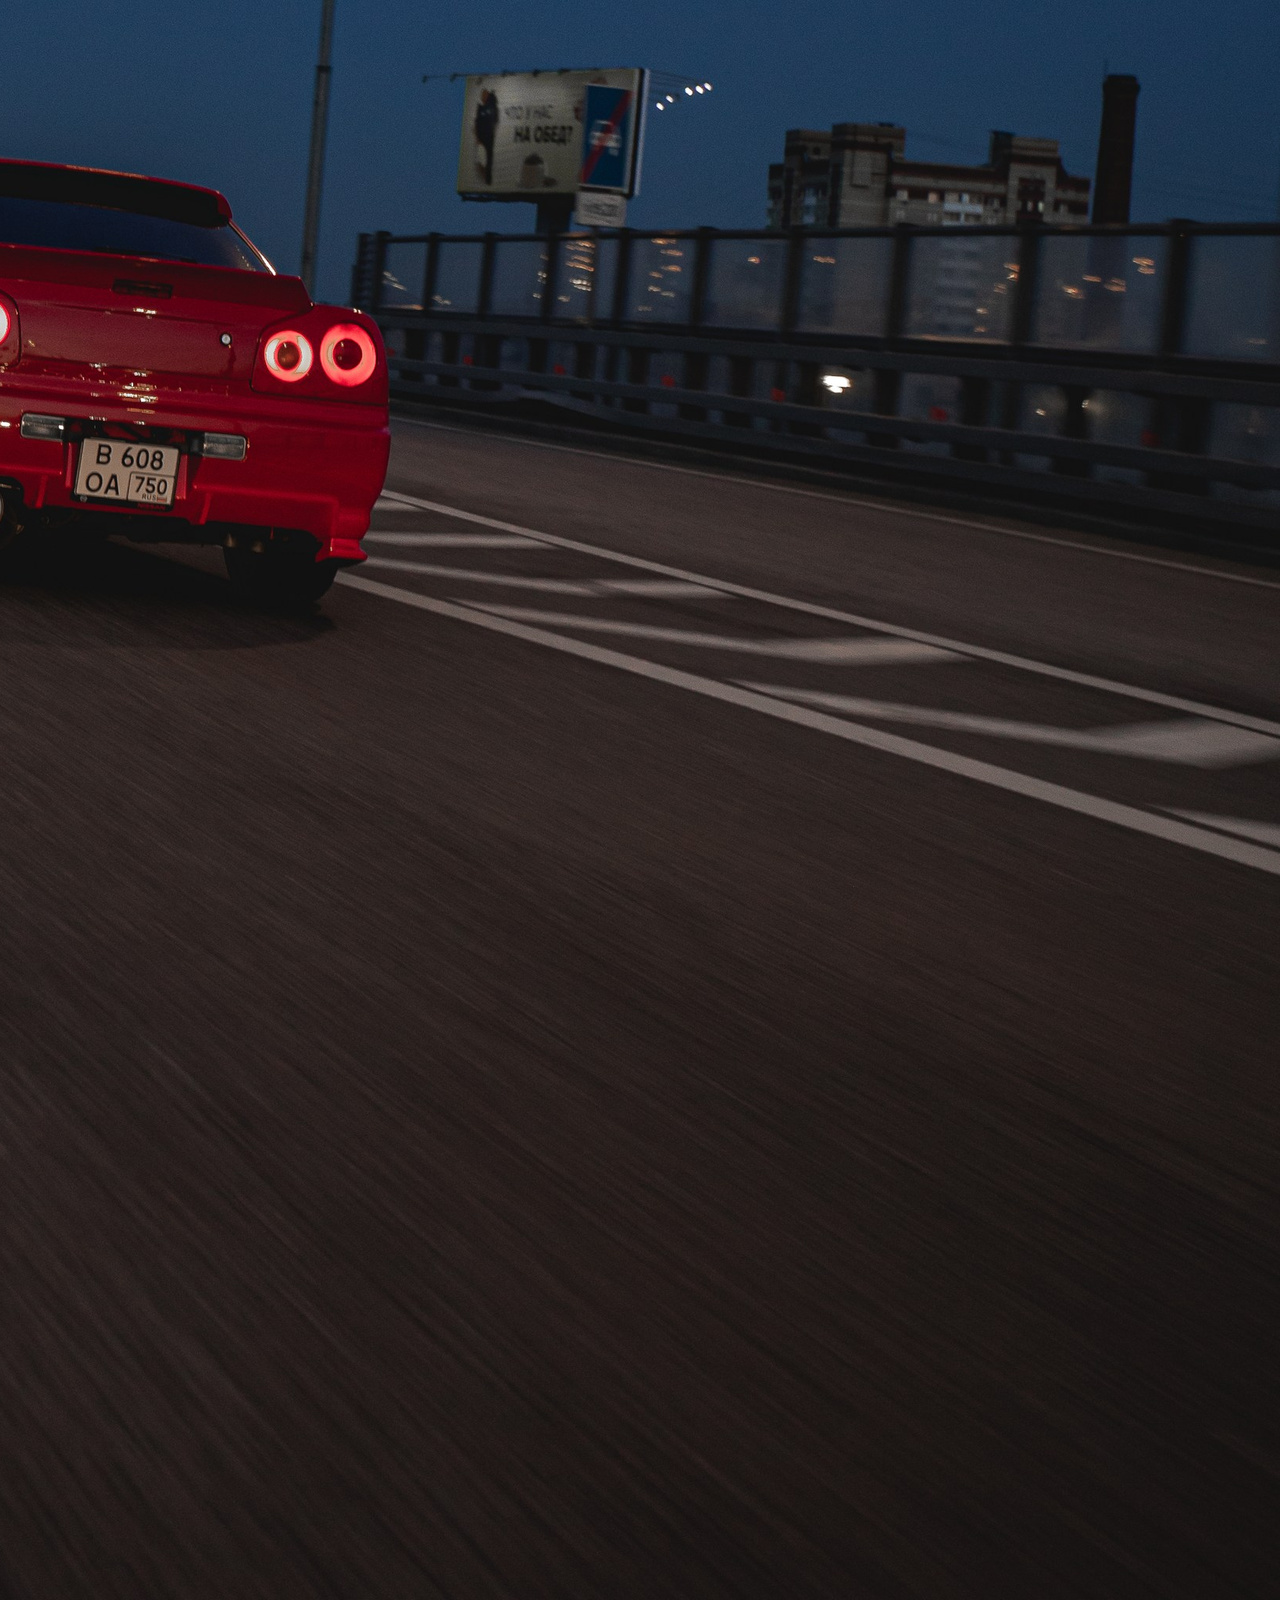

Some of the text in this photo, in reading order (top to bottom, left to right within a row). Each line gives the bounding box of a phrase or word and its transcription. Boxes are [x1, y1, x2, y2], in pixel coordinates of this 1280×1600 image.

[96, 443, 164, 471] В 608
[85, 472, 168, 496] ОА 750
[141, 493, 156, 501] RUS
